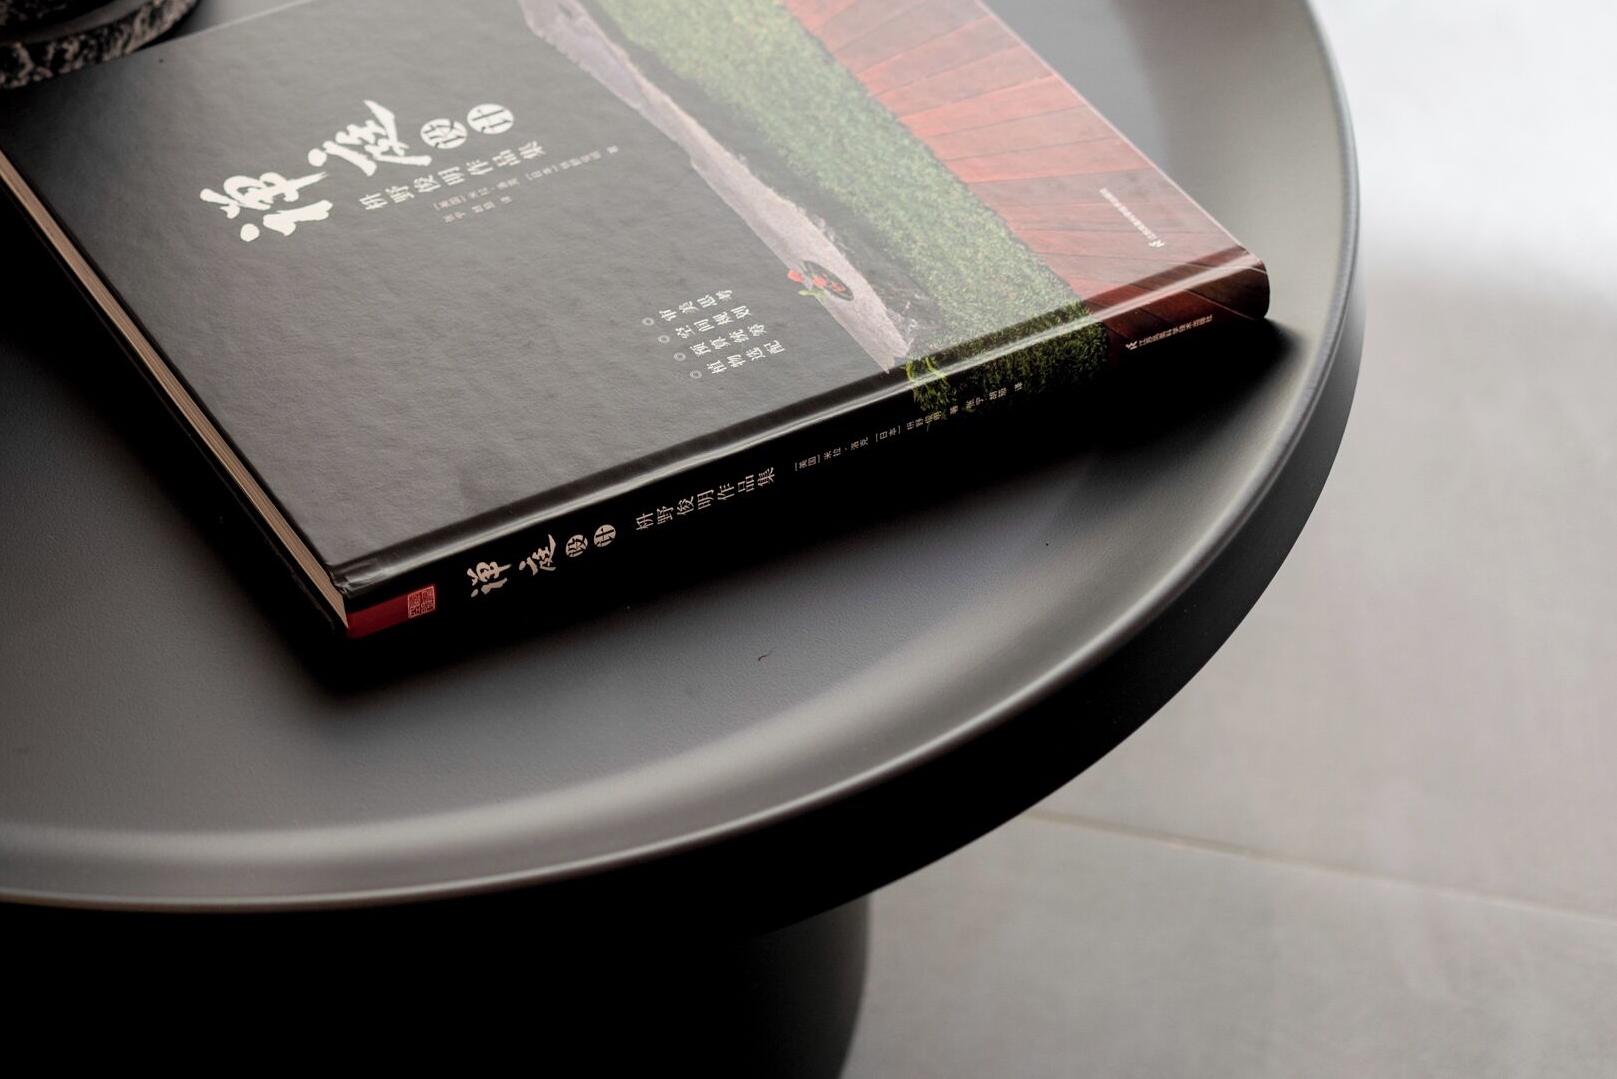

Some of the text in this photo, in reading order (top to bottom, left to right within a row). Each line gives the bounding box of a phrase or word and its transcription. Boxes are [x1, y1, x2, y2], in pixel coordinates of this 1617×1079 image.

[675, 305, 752, 339] 空间规划
[690, 323, 767, 357] 预算统筹
[706, 340, 786, 374] 植物选配
[635, 466, 777, 531] 枡野俊明作品集
